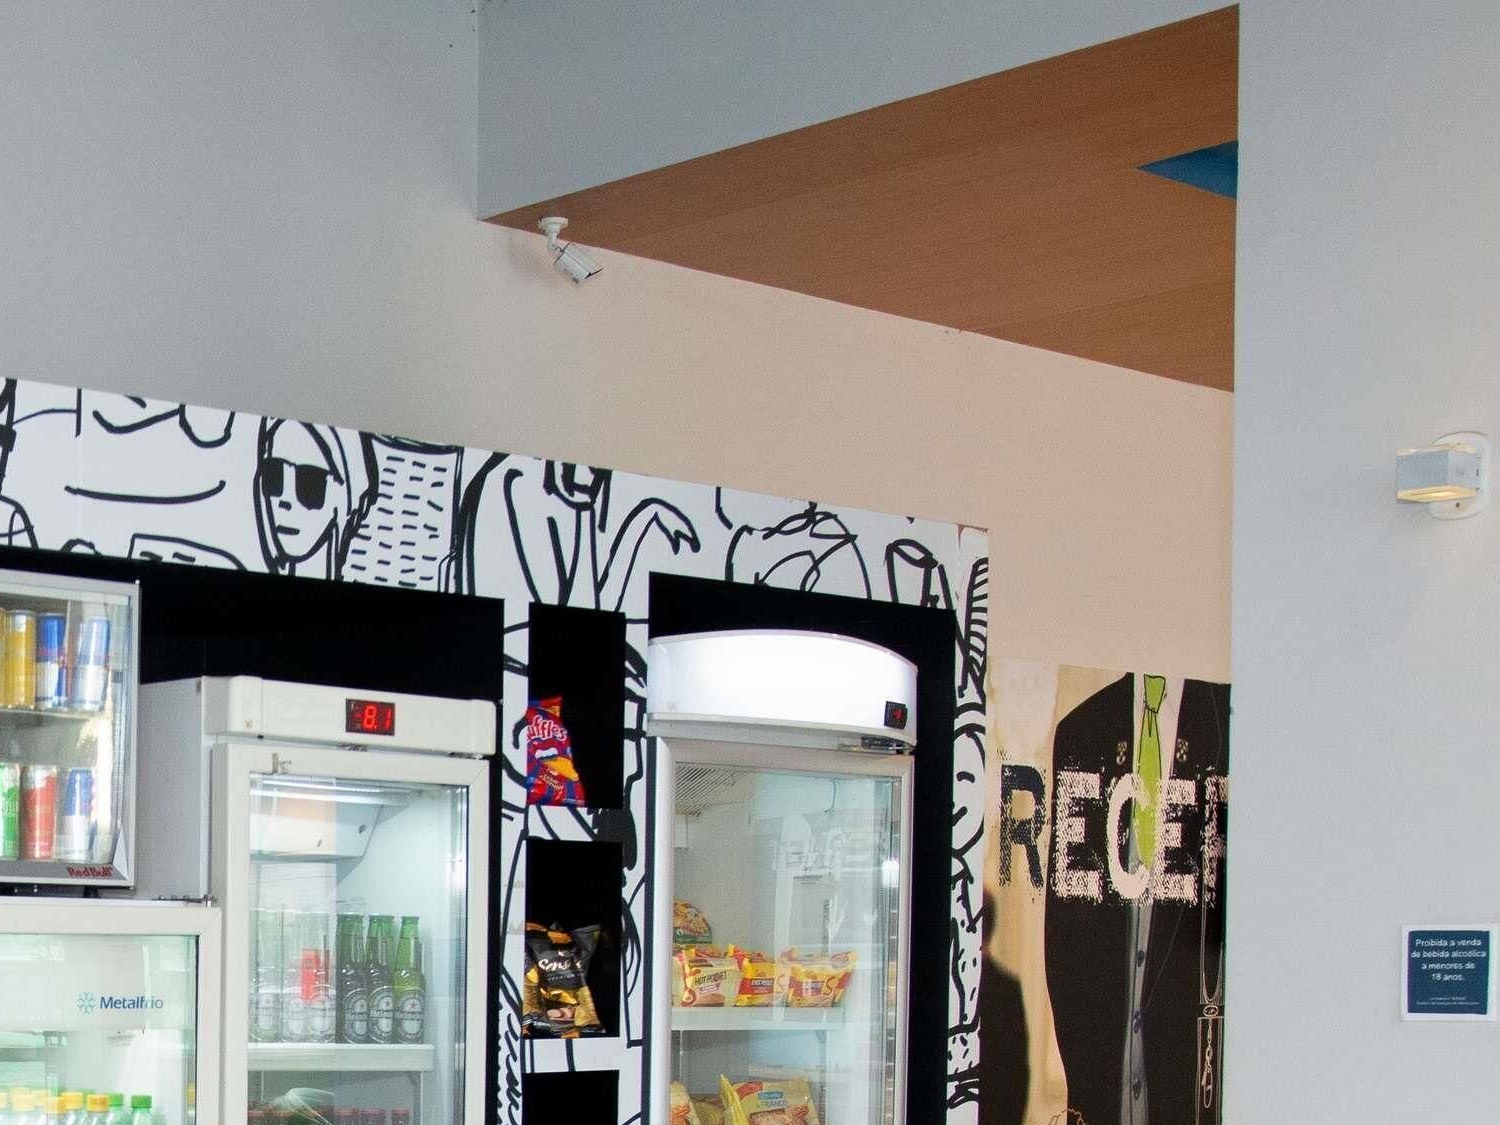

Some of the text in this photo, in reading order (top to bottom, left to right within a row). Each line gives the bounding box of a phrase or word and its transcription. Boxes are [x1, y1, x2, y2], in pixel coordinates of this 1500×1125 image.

[1415, 939, 1448, 947] Proibida
[1457, 939, 1482, 947] venda
[1465, 962, 1476, 970] de
[1432, 973, 1442, 981] 18
[100, 995, 164, 1009] Metalfrio
